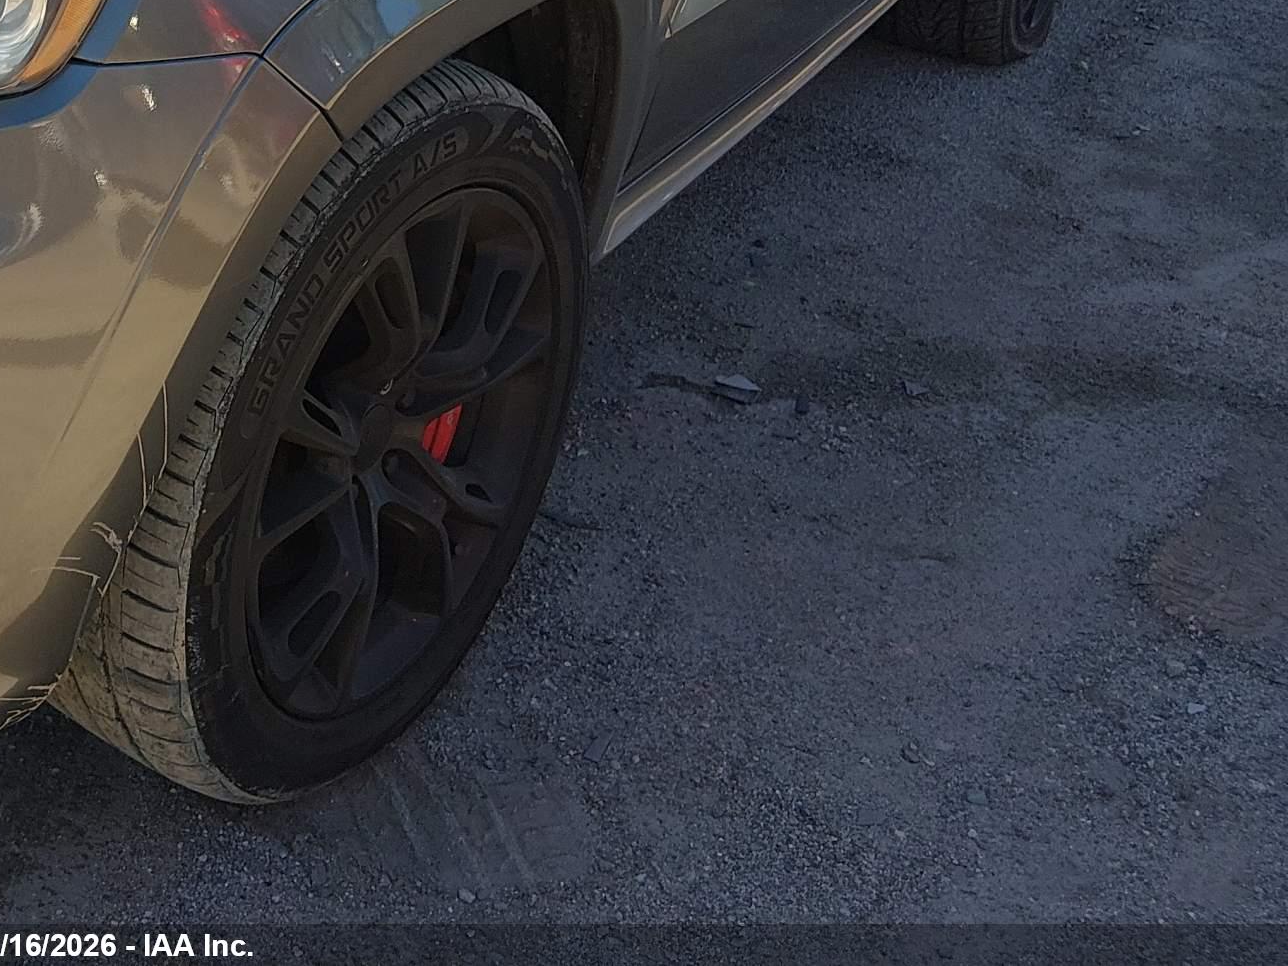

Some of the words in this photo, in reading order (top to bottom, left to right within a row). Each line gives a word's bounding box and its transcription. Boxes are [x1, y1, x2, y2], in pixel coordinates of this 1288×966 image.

[249, 275, 324, 416] GRAND
[324, 171, 403, 271] SPORT
[412, 132, 458, 179] A/S
